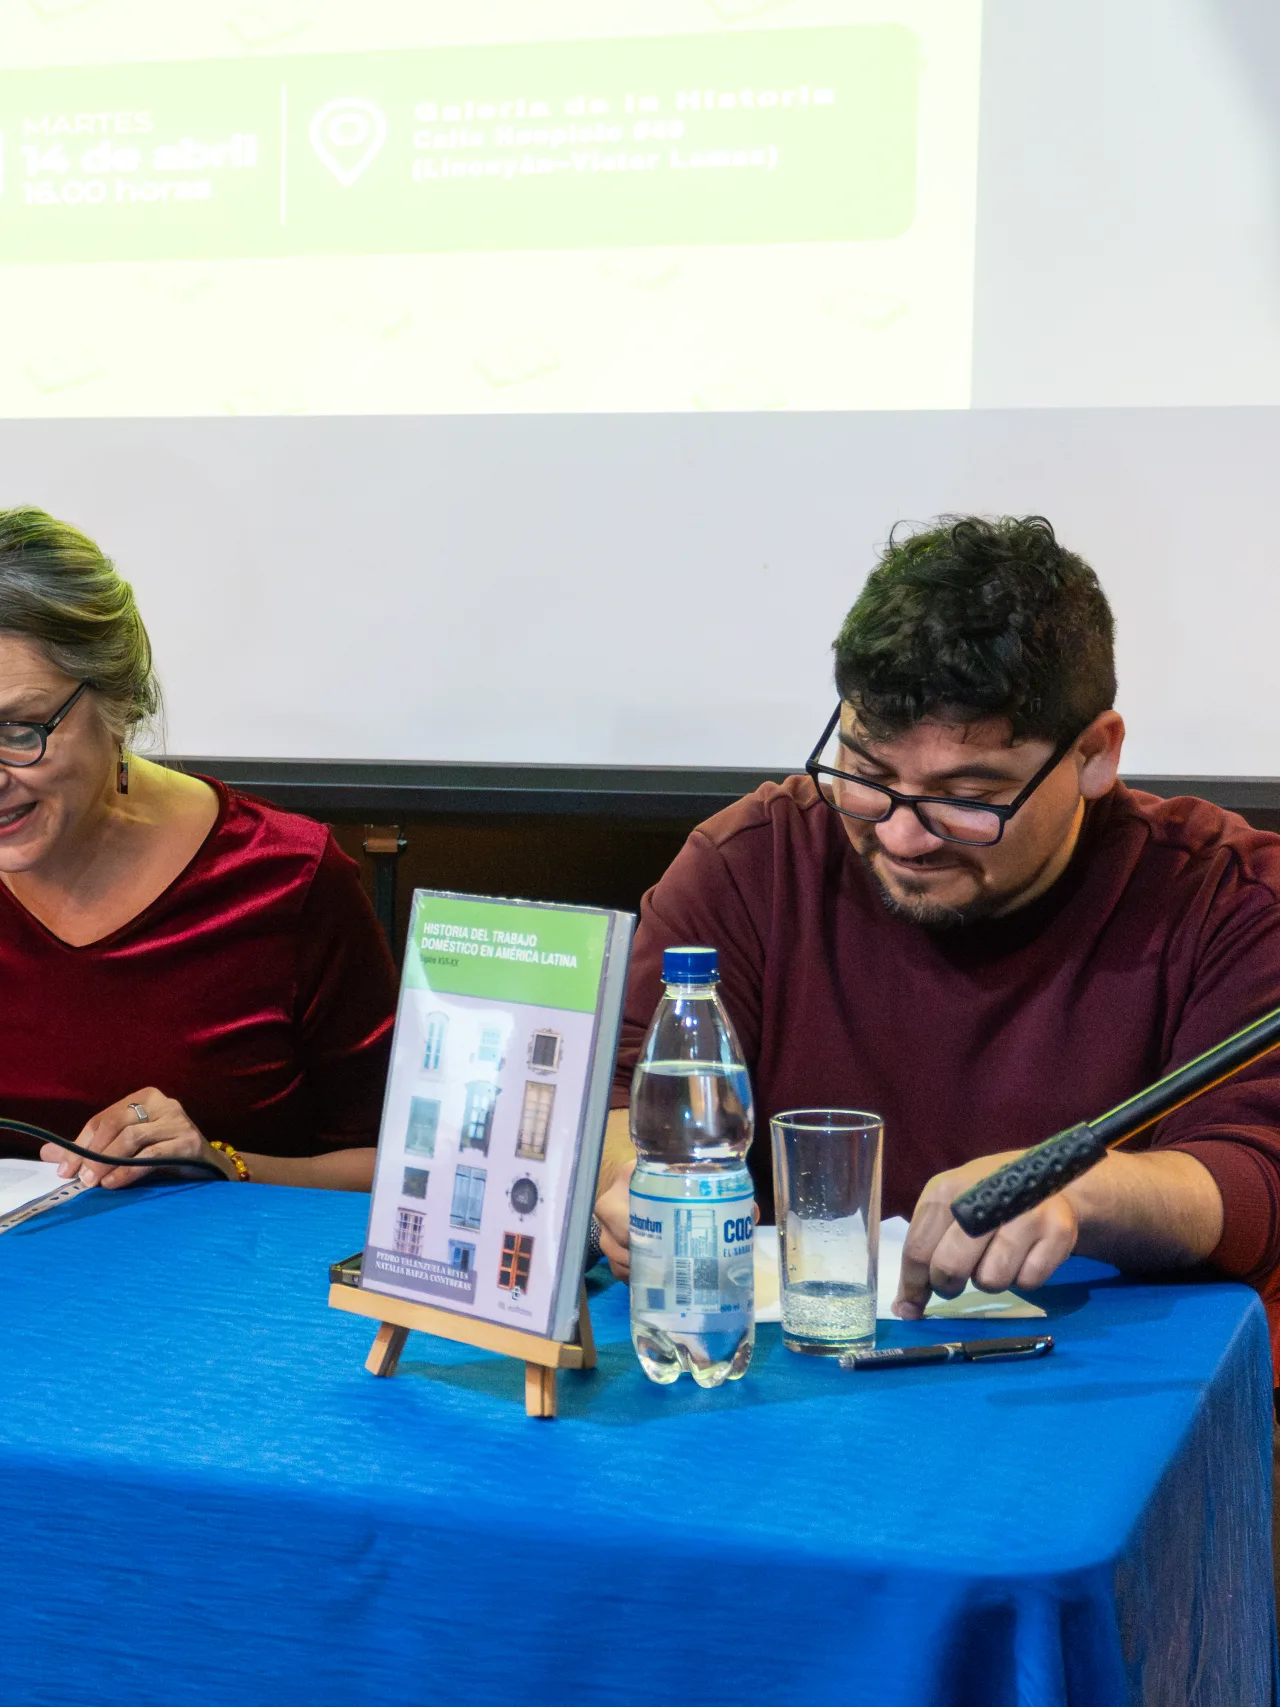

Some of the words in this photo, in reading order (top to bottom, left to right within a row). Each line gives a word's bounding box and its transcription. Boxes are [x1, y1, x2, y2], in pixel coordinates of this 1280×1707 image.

[21, 110, 154, 136] MARTES
[19, 141, 70, 176] 14
[80, 139, 141, 173] de
[151, 132, 258, 171] abril
[423, 922, 469, 940] HISTORIA
[470, 928, 489, 942] DEL
[492, 930, 538, 947] TRABAJO
[421, 936, 478, 956] DOMÉSTICO
[479, 945, 494, 958] EN
[495, 945, 540, 963] AMÉRICA
[540, 953, 578, 968] LATINA
[375, 1260, 404, 1275] NATALIA
[429, 1274, 472, 1291] CONTRERAS
[376, 1251, 400, 1264] PEDRO
[400, 1257, 446, 1275] VALENZUELA
[447, 1267, 469, 1280] REYES
